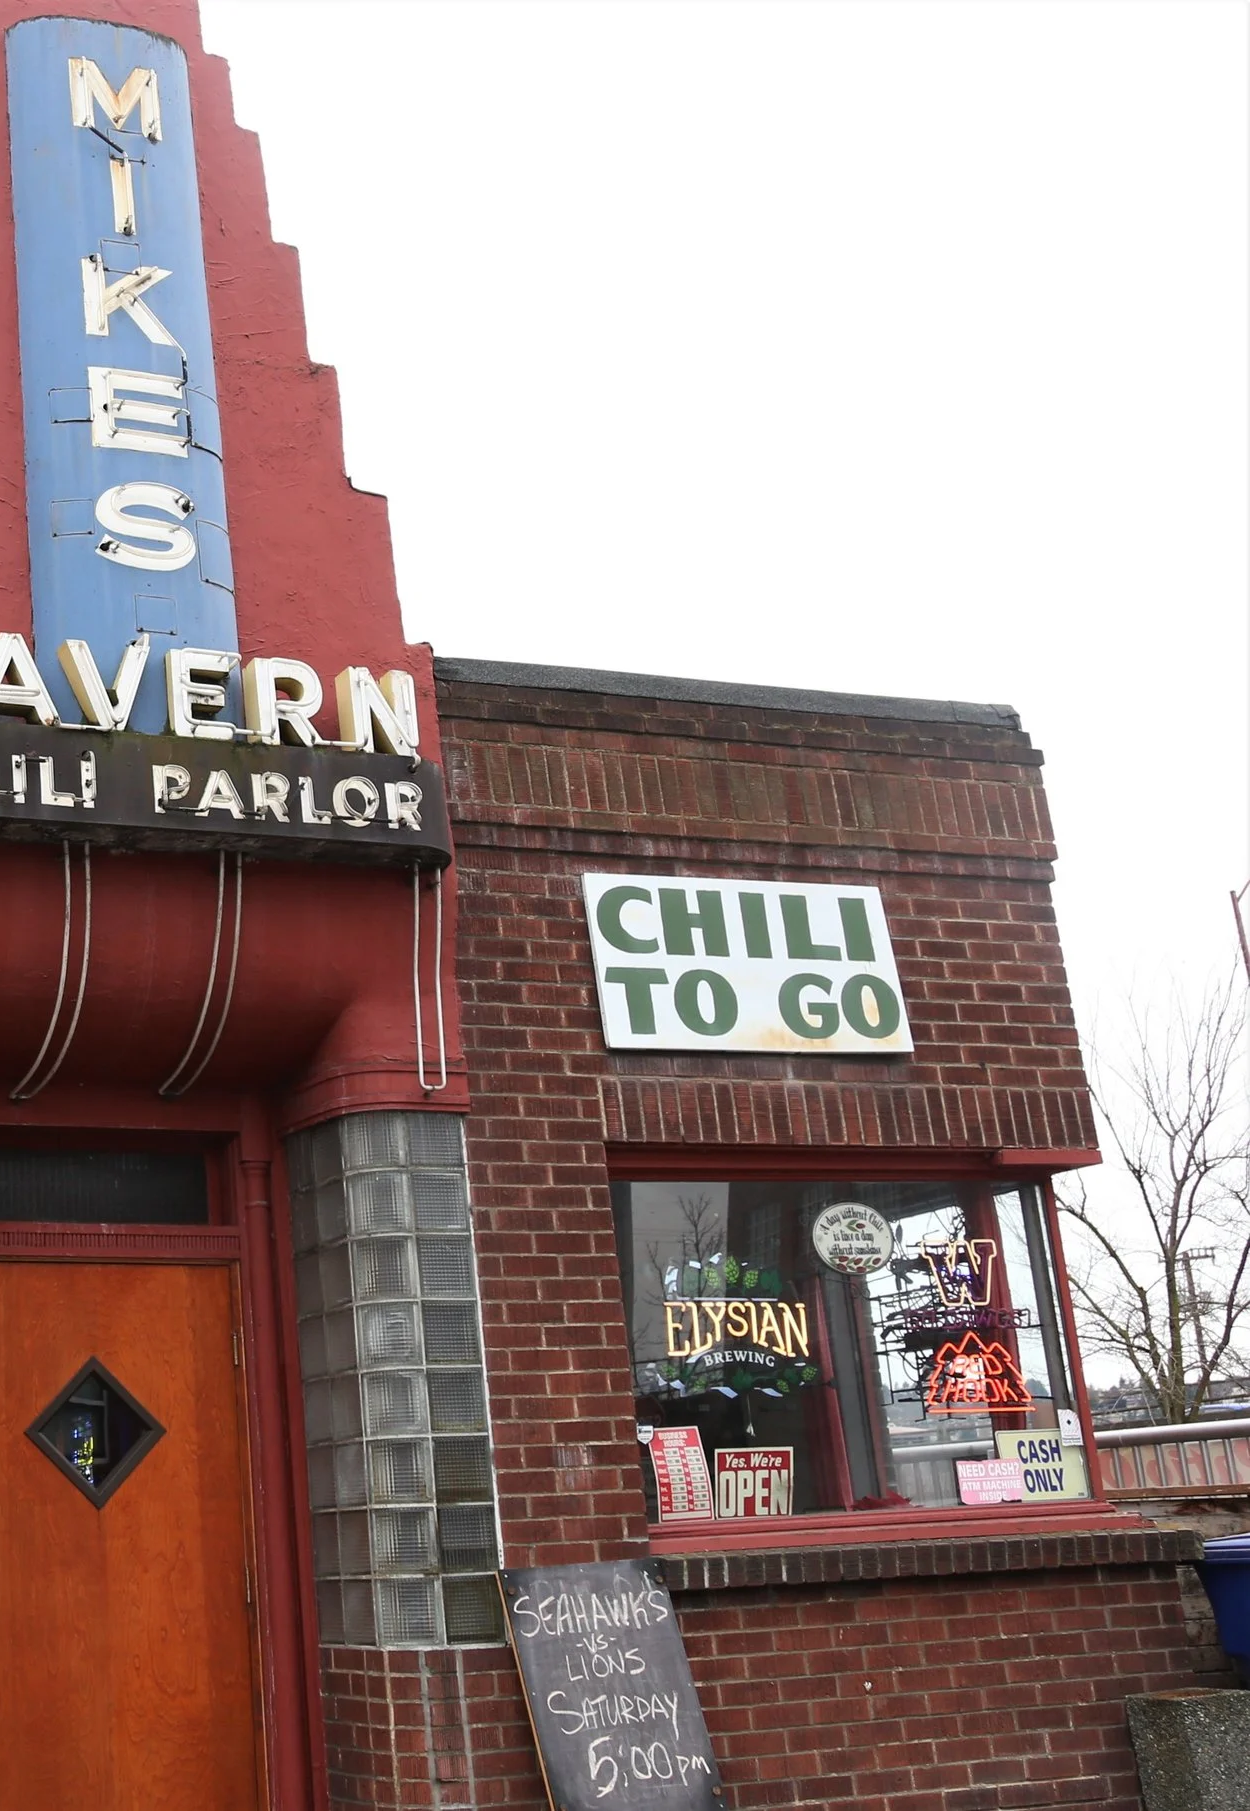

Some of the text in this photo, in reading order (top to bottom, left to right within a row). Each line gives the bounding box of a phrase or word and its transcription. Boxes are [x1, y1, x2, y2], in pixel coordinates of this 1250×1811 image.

[69, 57, 196, 571] MIKES
[153, 764, 423, 832] PARLOR
[596, 885, 876, 962] CHILI
[604, 966, 900, 1040] TO GO
[825, 1213, 842, 1227] day
[861, 1229, 875, 1246] day
[920, 1239, 998, 1307] W
[663, 1301, 810, 1358] ELYSIAN
[703, 1350, 776, 1368] BREWING
[949, 1353, 1004, 1376] RED
[941, 1377, 1019, 1403] HOOK
[750, 1452, 783, 1467] We're
[1017, 1438, 1063, 1464] CASH
[958, 1462, 1020, 1477] NEED CASH?
[1023, 1467, 1064, 1494] ONLY
[719, 1469, 789, 1518] OPEN
[962, 1479, 1022, 1491] ATM MACHINE
[979, 1490, 1008, 1501] INSIDE
[513, 1590, 668, 1638] SEAHAWKS
[565, 1648, 646, 1681] LIONS
